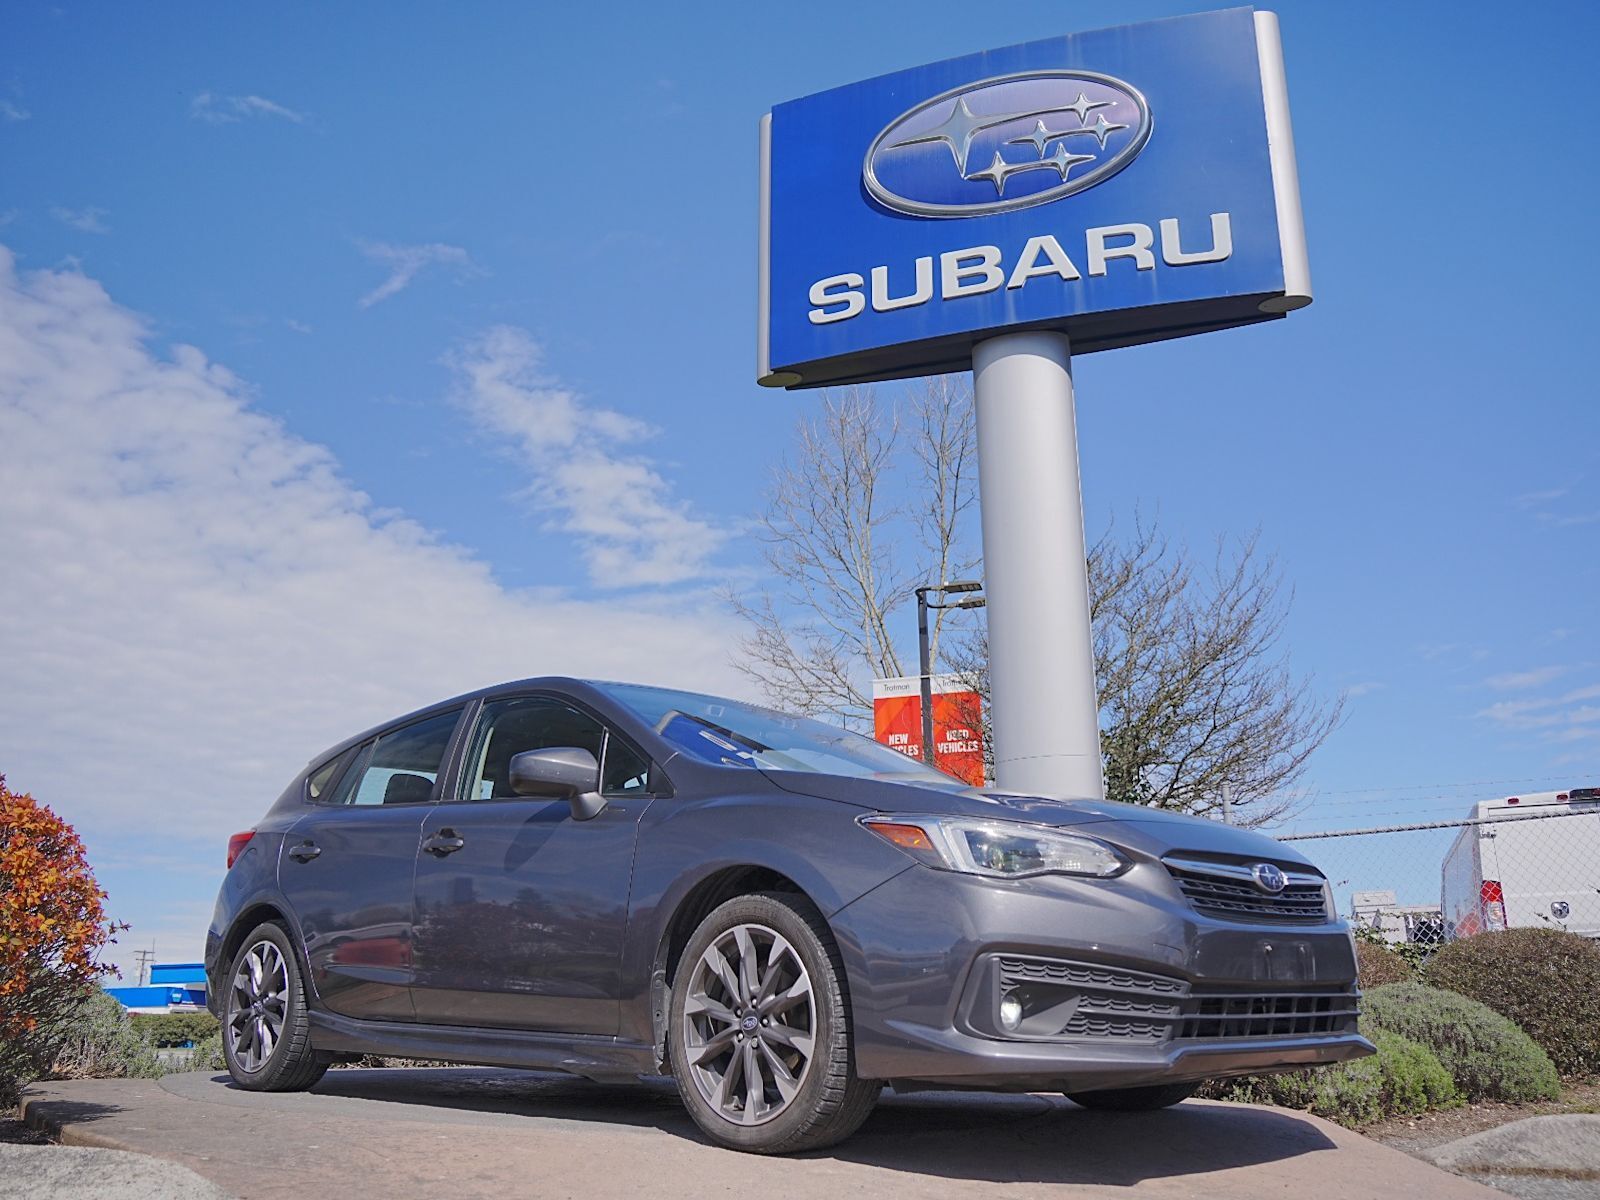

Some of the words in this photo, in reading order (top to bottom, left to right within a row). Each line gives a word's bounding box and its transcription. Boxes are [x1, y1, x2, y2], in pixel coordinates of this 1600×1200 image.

[808, 212, 1233, 325] SUBARU
[884, 684, 911, 692] Trotman
[889, 733, 909, 745] NEW
[937, 741, 979, 754] VEHICLES
